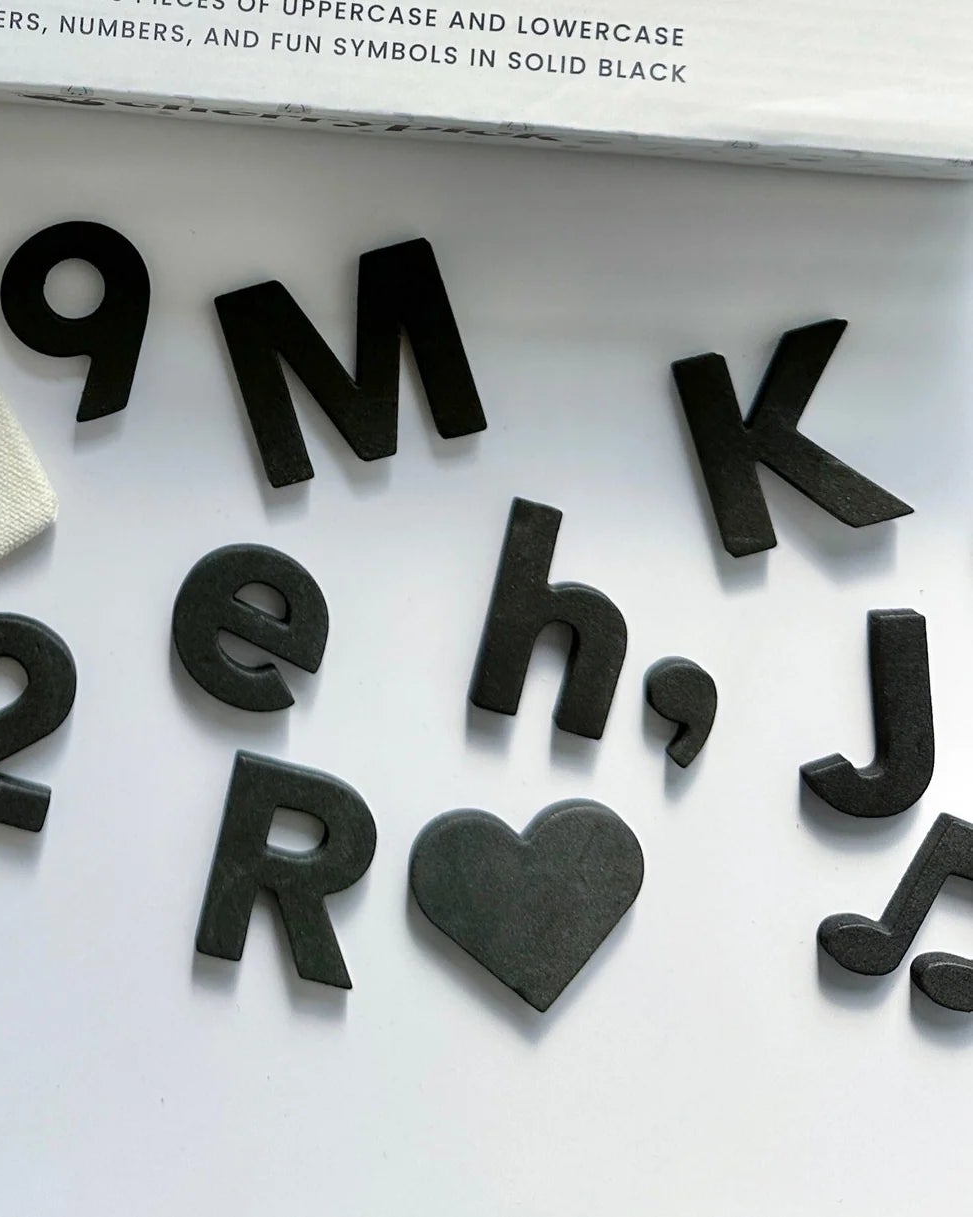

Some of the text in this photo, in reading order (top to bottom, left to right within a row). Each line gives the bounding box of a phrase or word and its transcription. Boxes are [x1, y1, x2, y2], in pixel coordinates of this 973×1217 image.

[59, 15, 193, 47] NUMBERS,
[203, 27, 259, 48] AND
[271, 32, 321, 54] FUN
[333, 37, 457, 65] SYMBOLS
[470, 48, 495, 68] IN
[508, 51, 586, 75] SOLID
[598, 58, 686, 83] BLACK
[448, 10, 506, 32] AND
[517, 15, 684, 47] LOWERCASE
